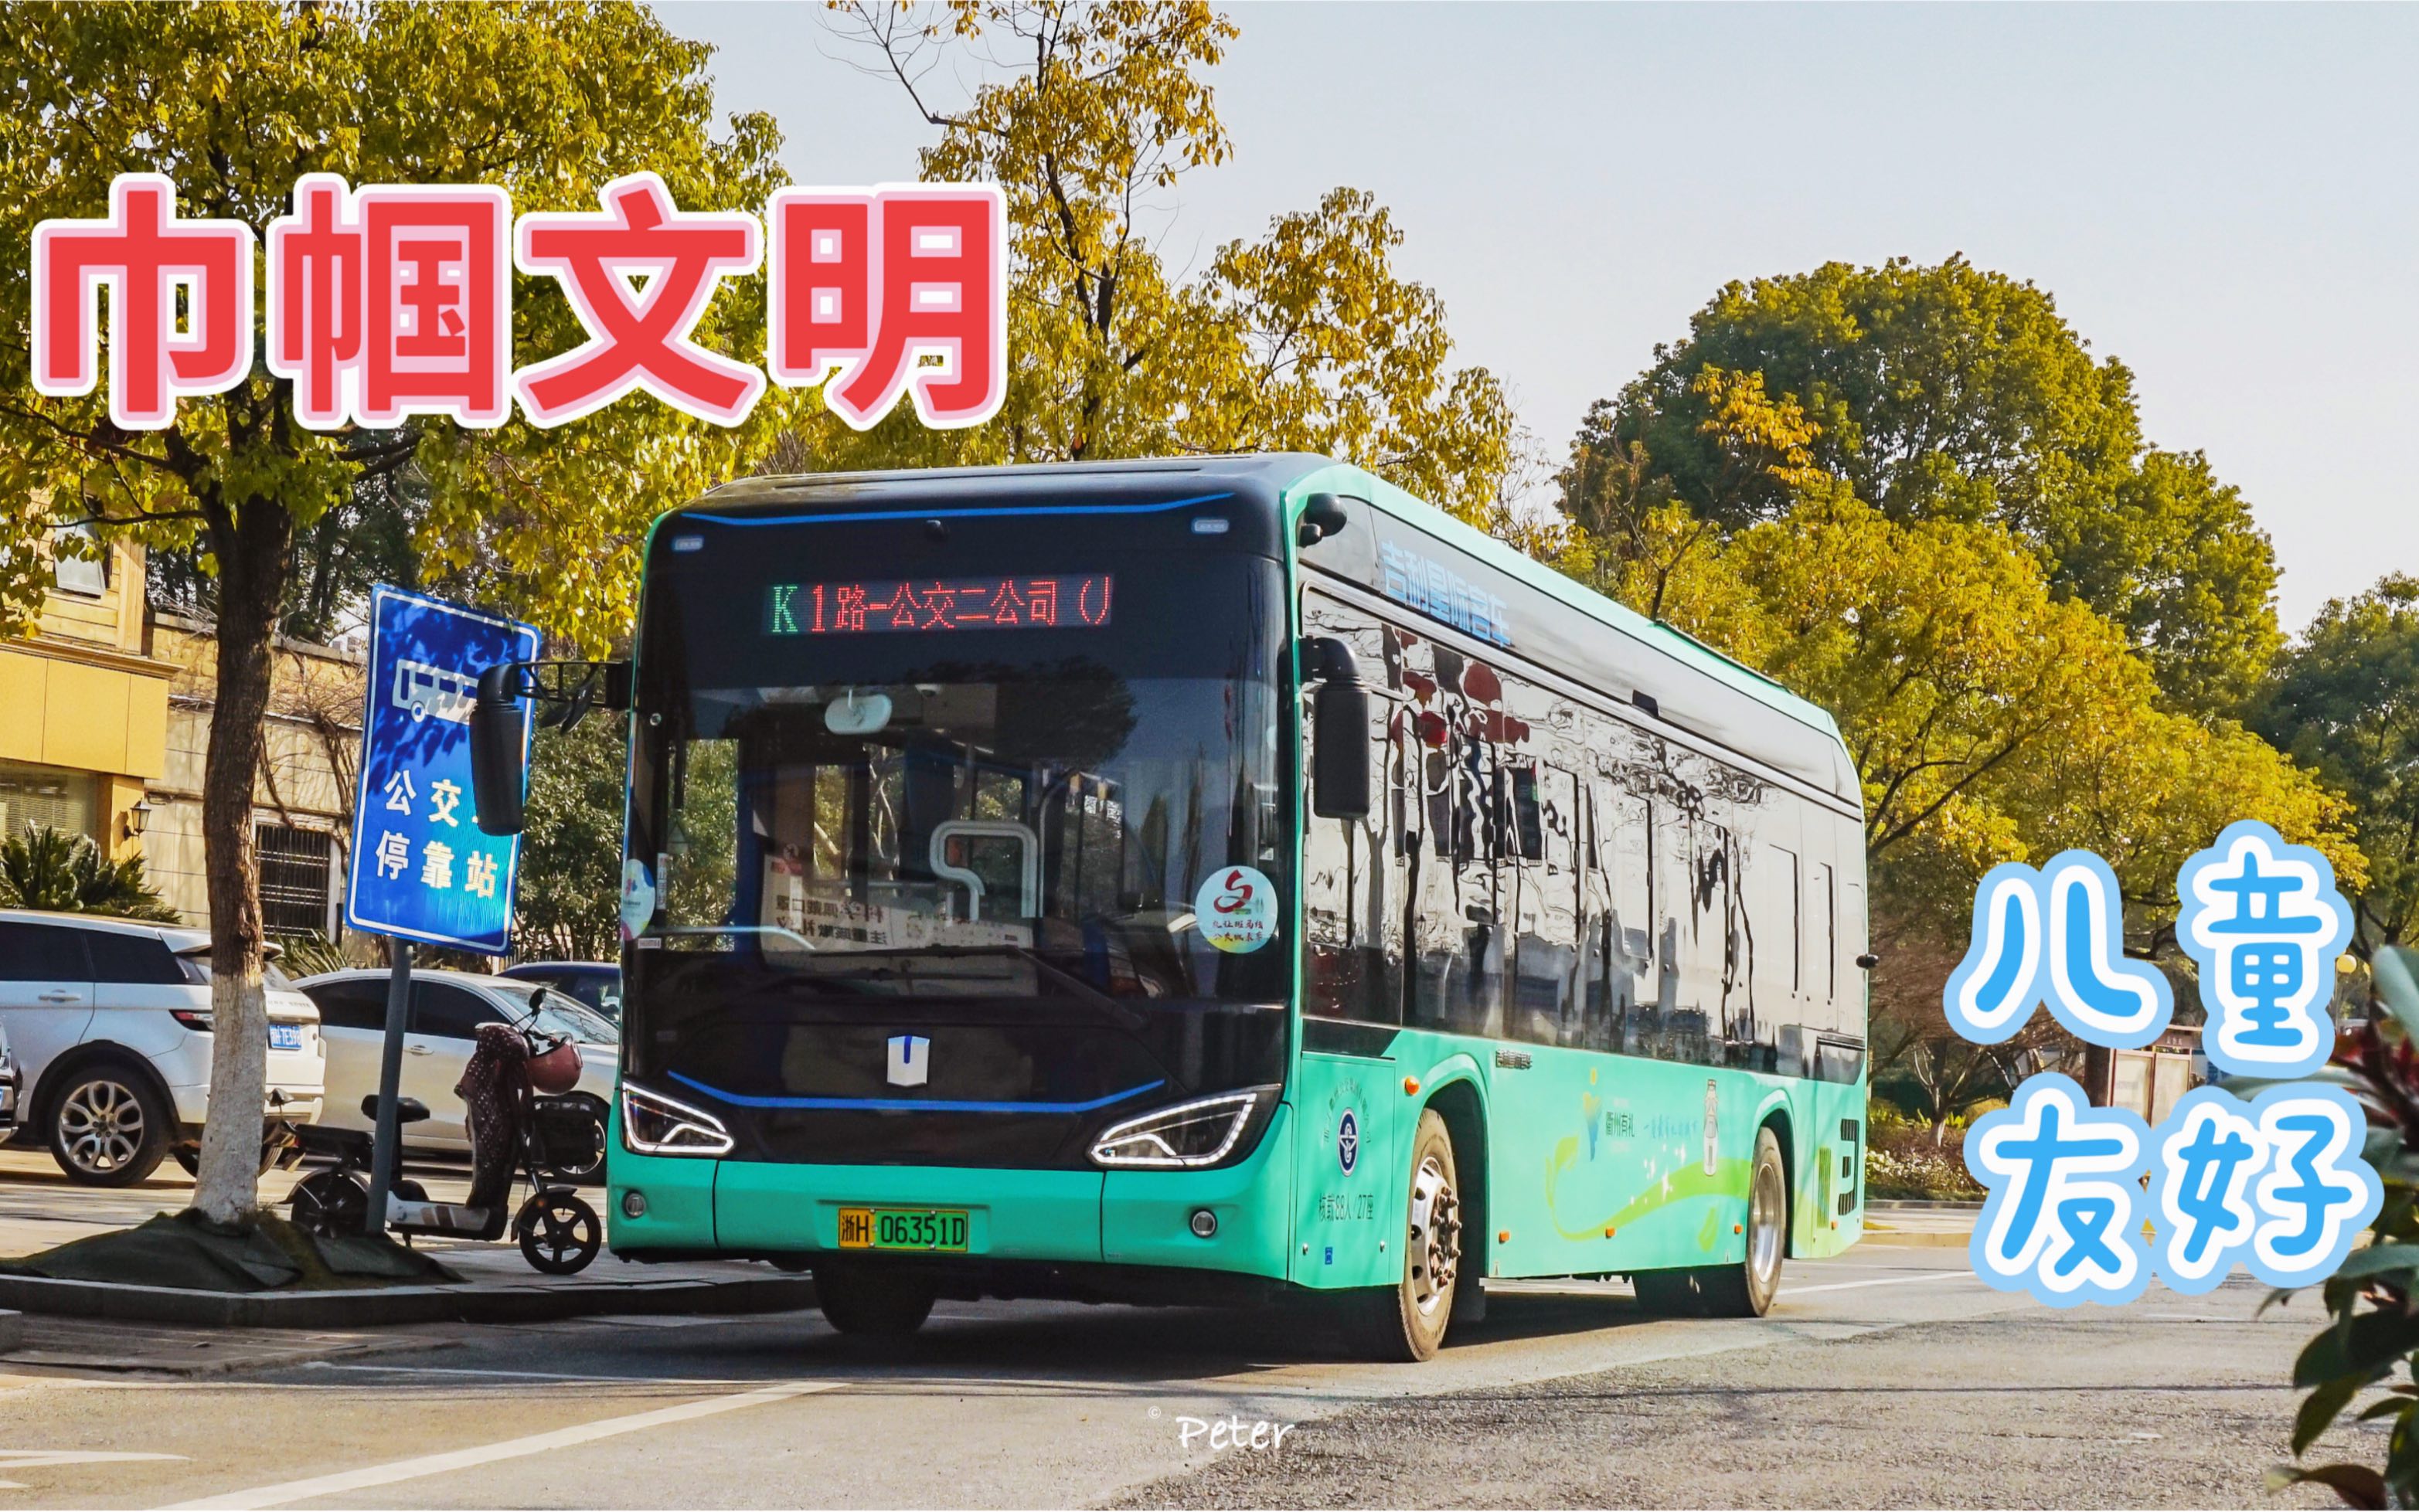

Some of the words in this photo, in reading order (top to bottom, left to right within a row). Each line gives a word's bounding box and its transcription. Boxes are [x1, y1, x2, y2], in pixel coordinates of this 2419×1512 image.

[383, 769, 479, 827] 公交
[375, 830, 499, 899] 停靠站
[841, 1213, 966, 1246] 浙H06351D
